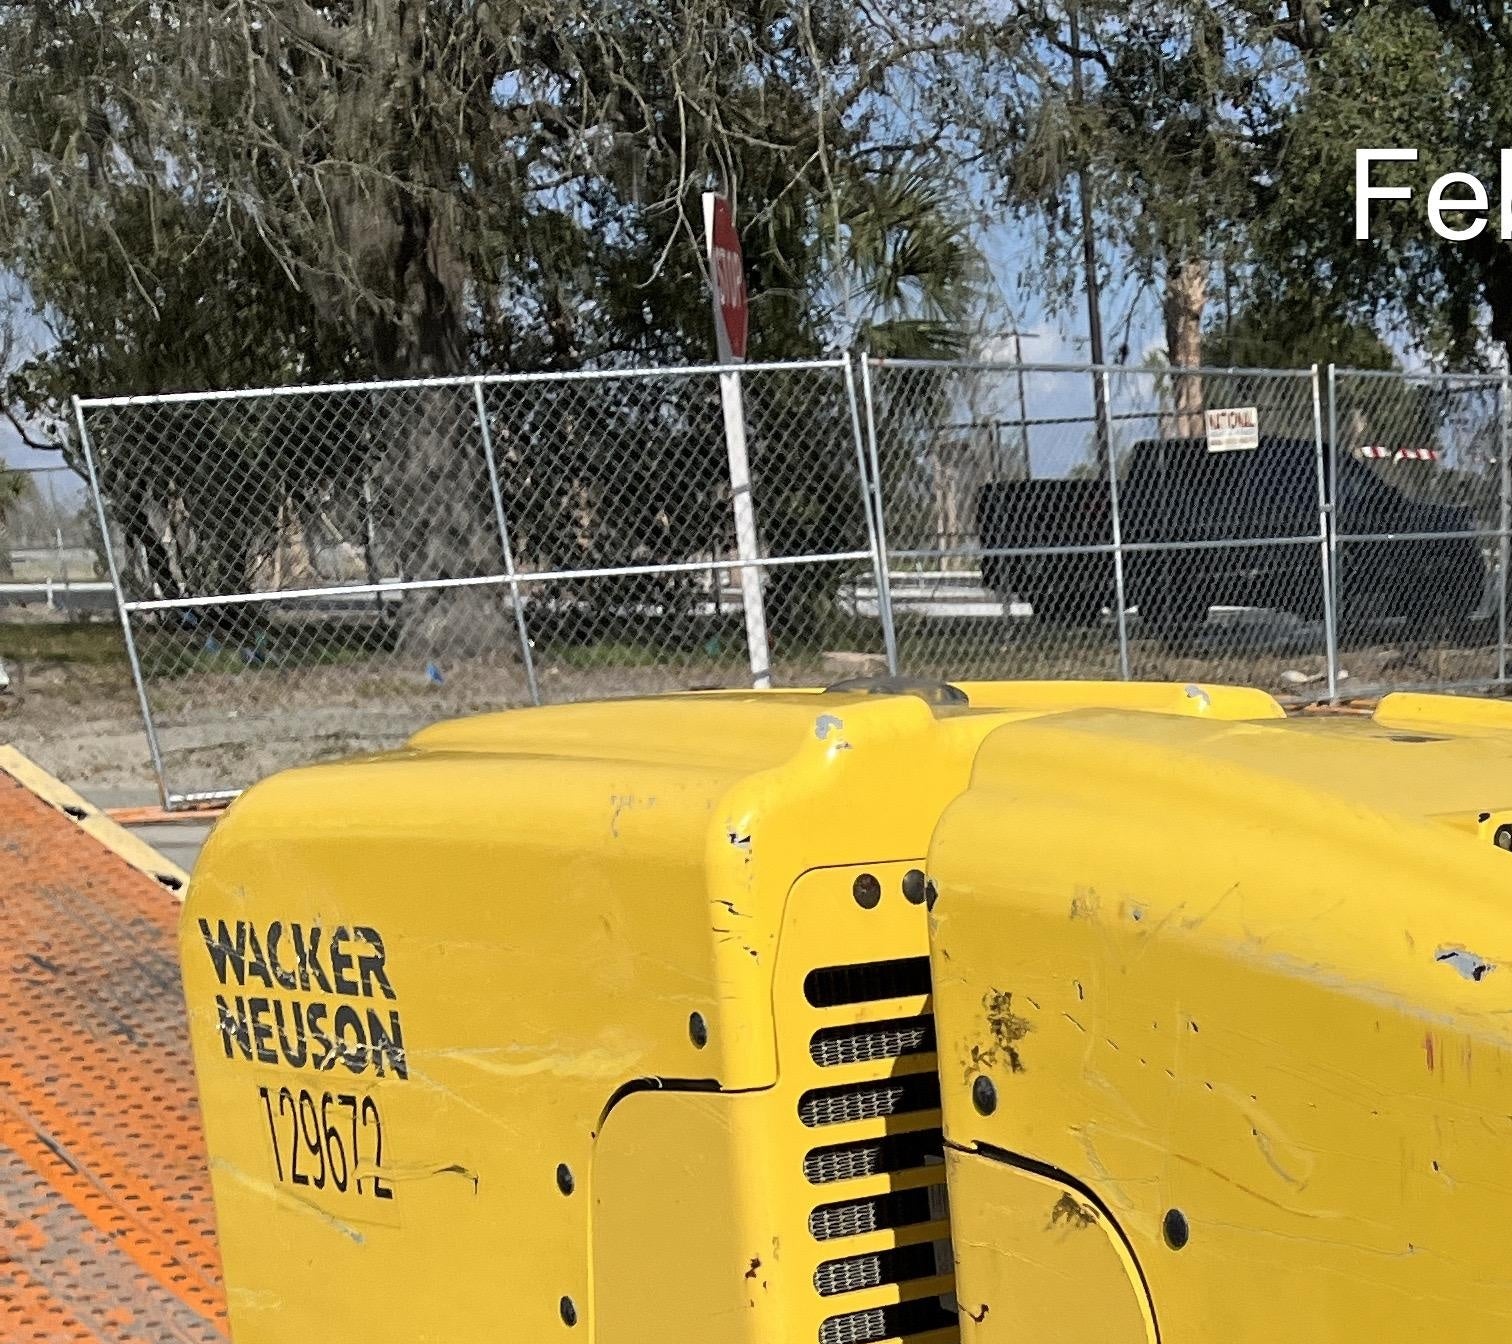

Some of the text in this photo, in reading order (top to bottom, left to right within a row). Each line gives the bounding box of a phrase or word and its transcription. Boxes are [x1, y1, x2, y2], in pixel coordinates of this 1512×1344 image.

[198, 917, 397, 1001] WACKER
[214, 994, 409, 1080] NEUSON
[257, 1085, 394, 1200] 129672
